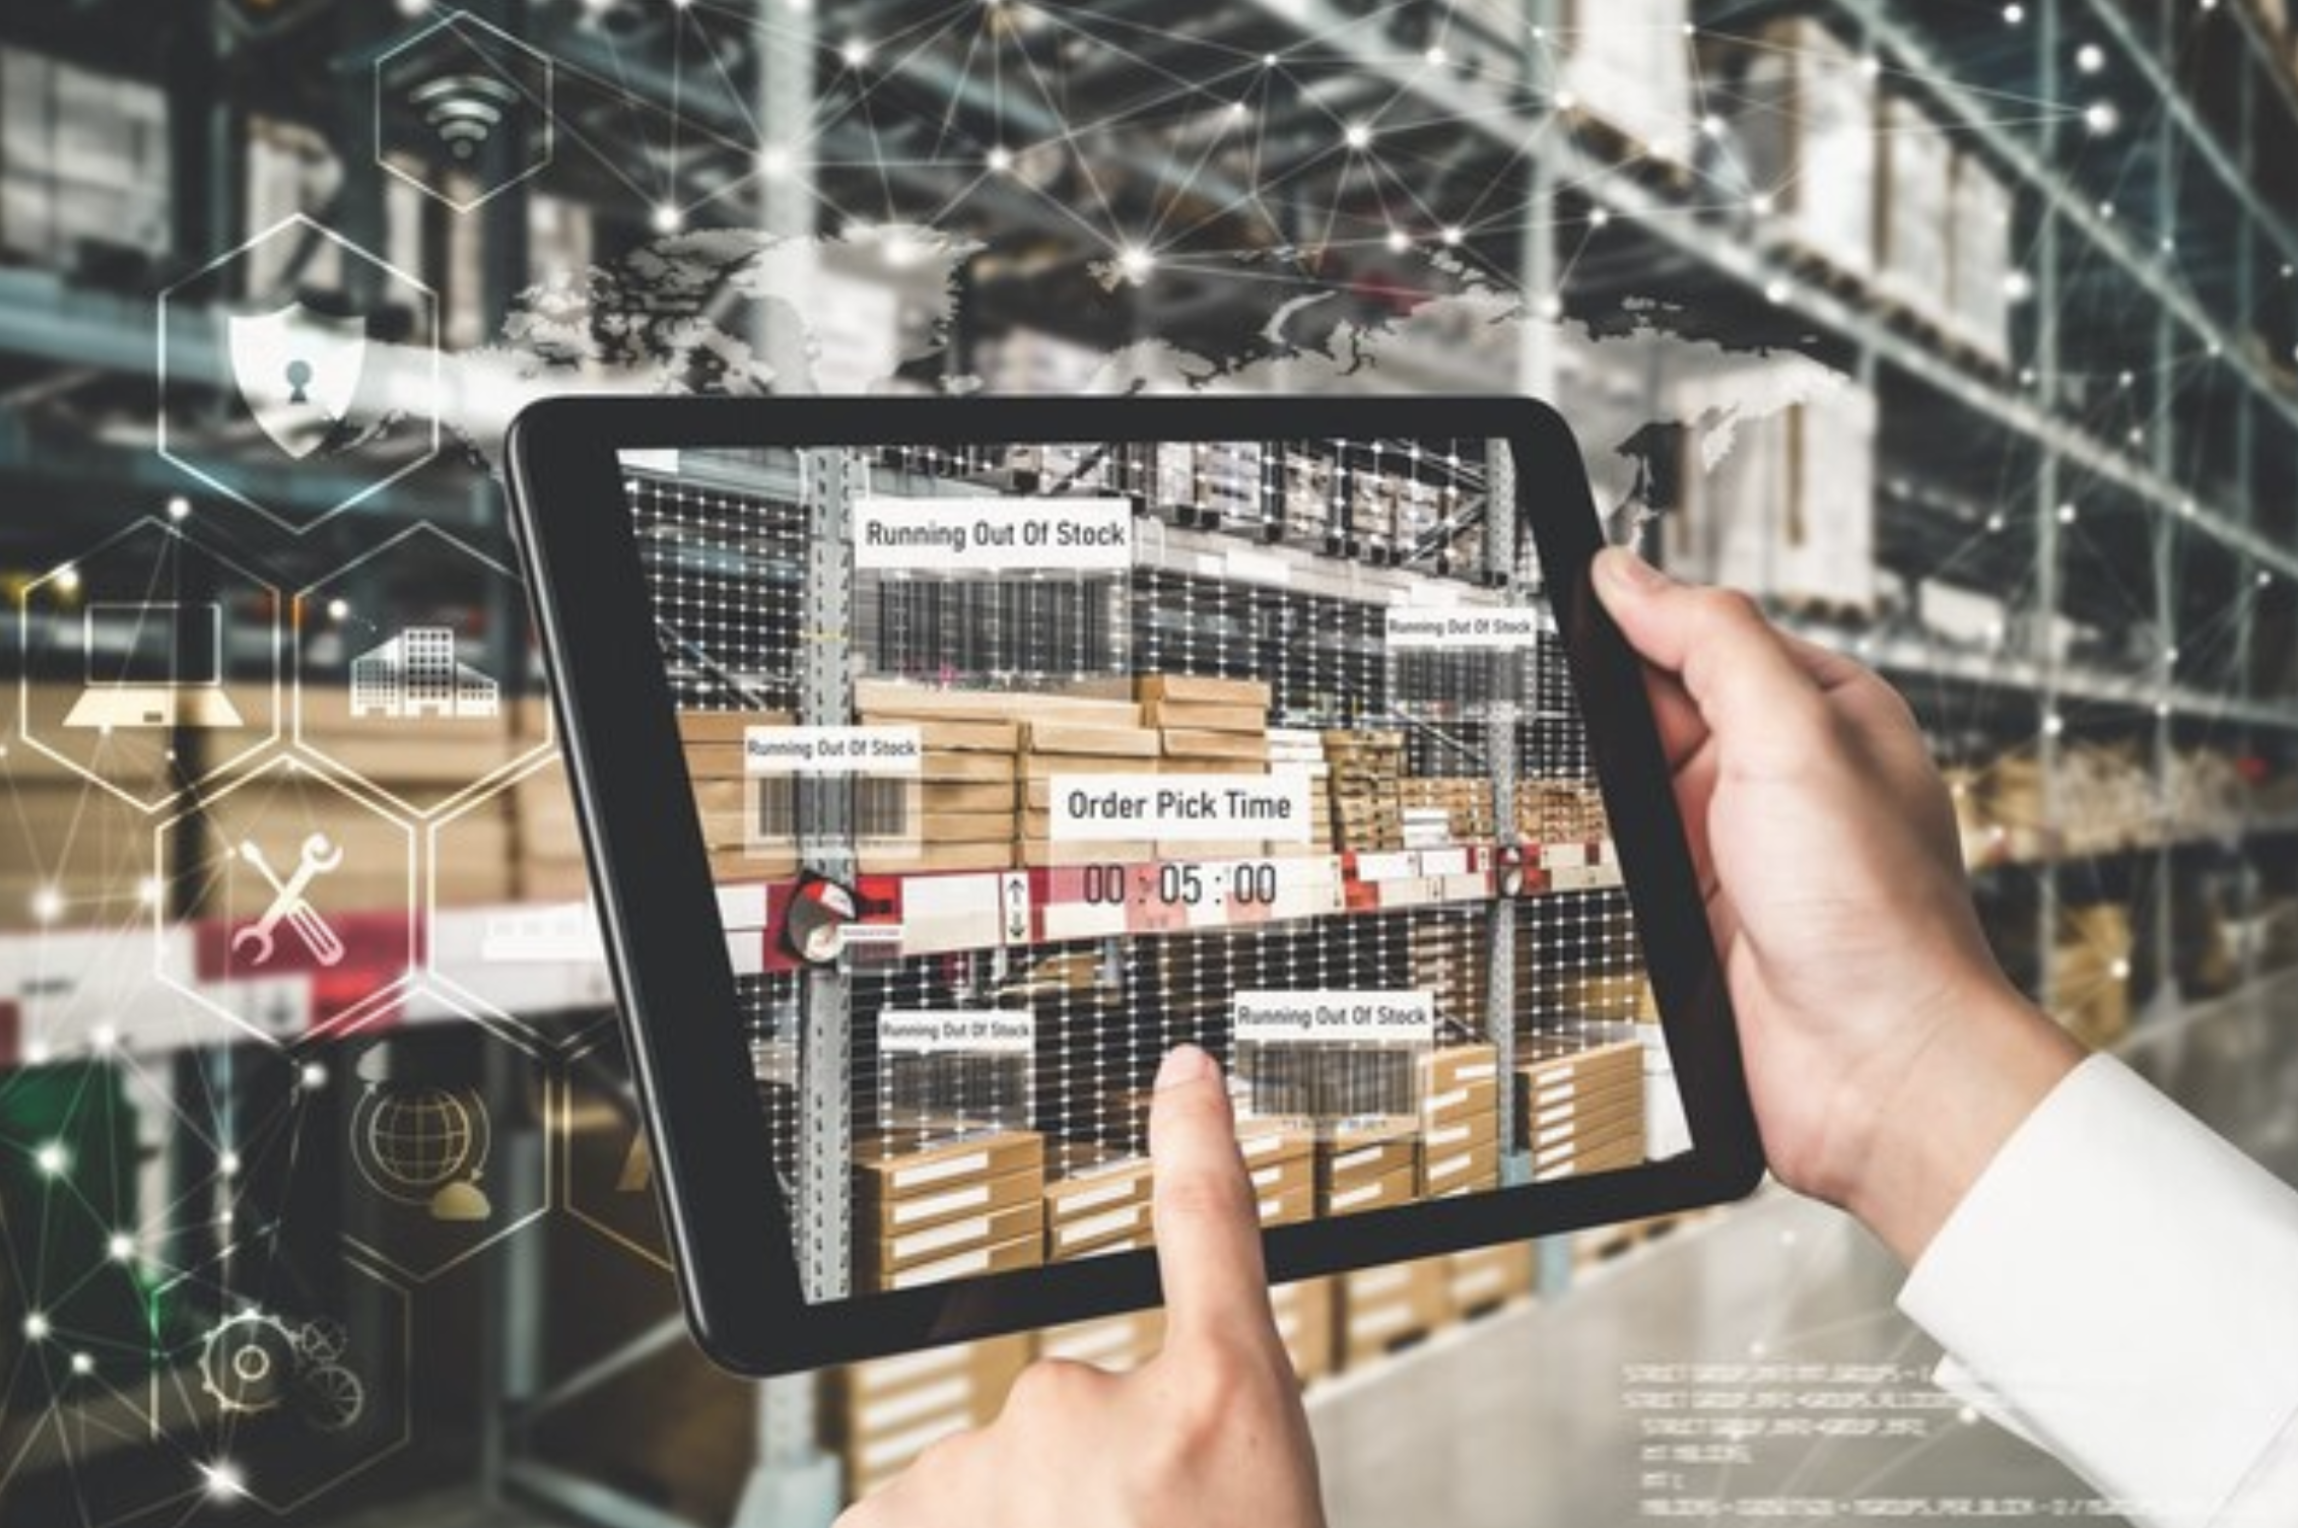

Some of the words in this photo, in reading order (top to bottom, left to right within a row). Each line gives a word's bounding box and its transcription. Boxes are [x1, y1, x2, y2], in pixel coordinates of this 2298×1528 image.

[866, 520, 967, 552] Running
[973, 520, 1015, 546] Out
[1023, 520, 1048, 546] Of
[1056, 520, 1125, 546] Stock
[1388, 618, 1445, 637] Running
[1448, 618, 1472, 634] Out
[1474, 618, 1490, 634] Of
[1494, 618, 1531, 634] Stock
[748, 739, 812, 760] Running
[818, 739, 844, 756] Out
[851, 739, 867, 756] Of
[871, 739, 916, 756] Stock
[1068, 790, 1147, 819] Order
[1157, 790, 1217, 819] Pick
[1225, 790, 1292, 819] Time
[1238, 1006, 1312, 1029] Running
[1315, 1006, 1347, 1025] Out
[1352, 1006, 1371, 1025] Of
[1377, 1006, 1427, 1025] Stock
[882, 1022, 938, 1041] Running
[943, 1022, 966, 1037] Out
[971, 1022, 986, 1037] Of
[990, 1022, 1029, 1037] Stock
